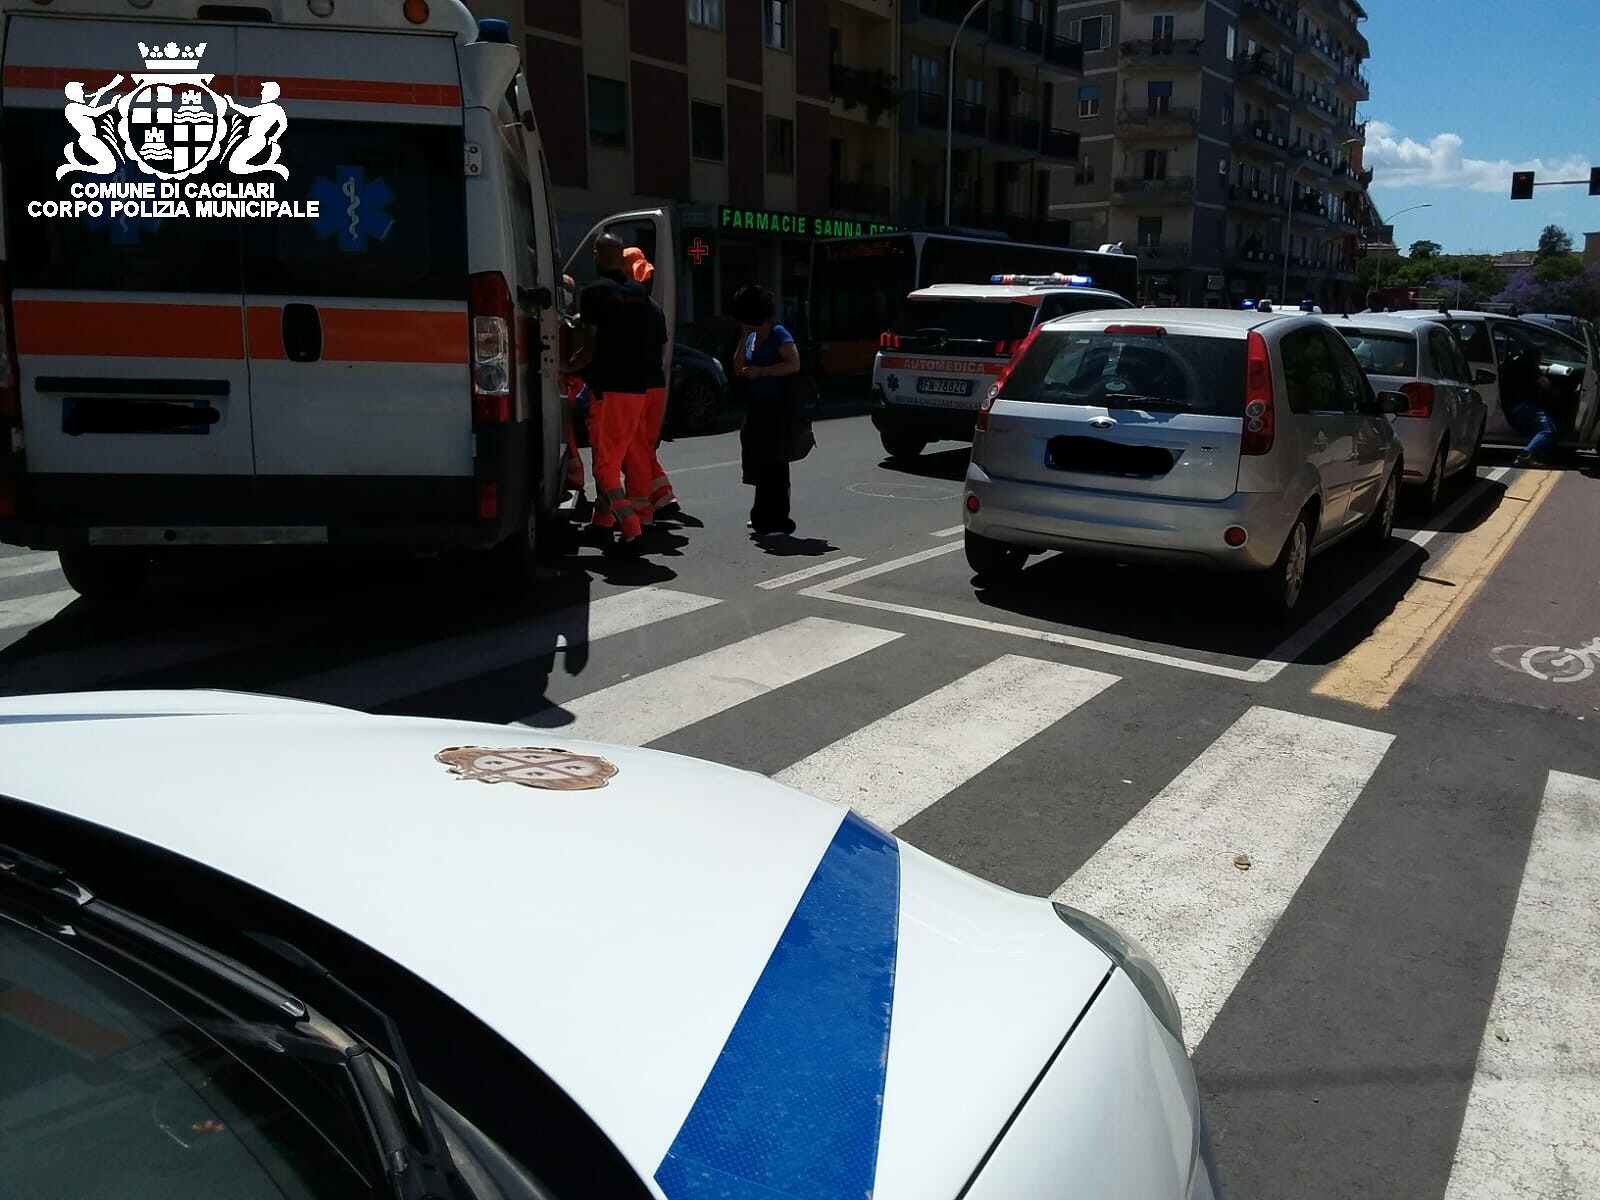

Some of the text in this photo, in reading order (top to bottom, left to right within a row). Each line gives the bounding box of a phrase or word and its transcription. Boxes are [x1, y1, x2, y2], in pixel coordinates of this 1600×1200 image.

[722, 208, 806, 233] FARMACIE
[815, 218, 862, 237] SANNA
[903, 359, 985, 373] AUTOMEDICA
